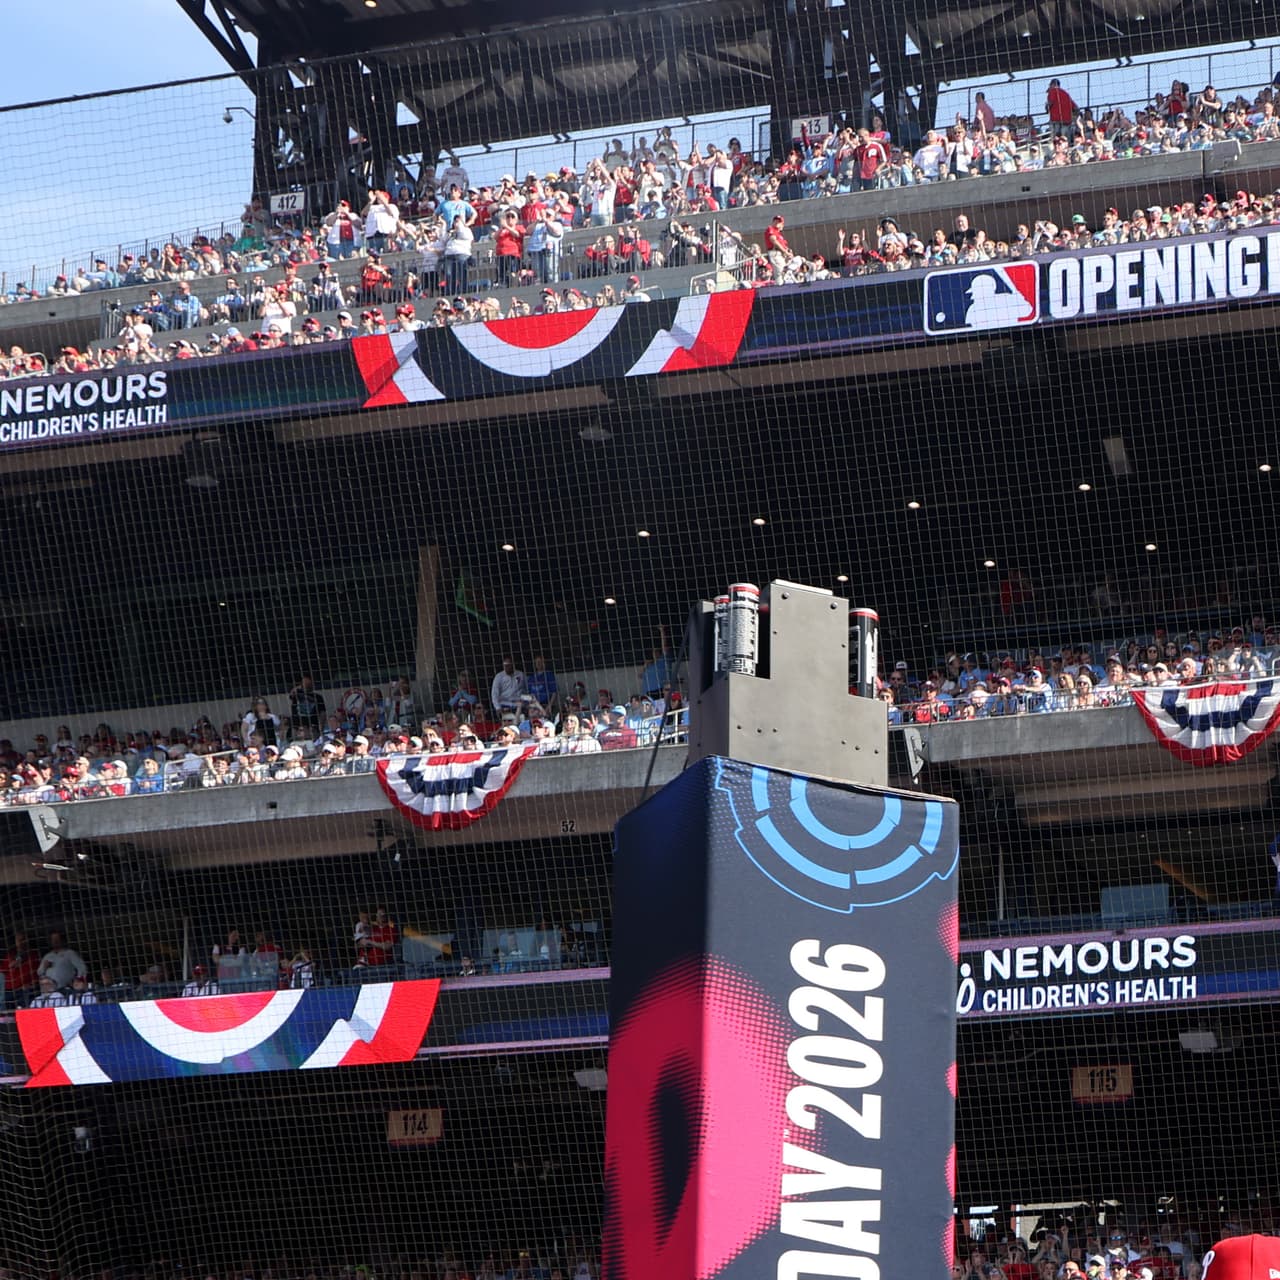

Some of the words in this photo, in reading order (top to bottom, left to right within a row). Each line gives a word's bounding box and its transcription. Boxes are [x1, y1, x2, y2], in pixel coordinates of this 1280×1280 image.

[277, 194, 297, 211] 412
[1048, 235, 1261, 319] OPENING
[0, 371, 168, 417] NEMOURS
[0, 411, 99, 443] CHILDREN'S
[102, 403, 168, 431] HEALTH
[561, 820, 576, 833] 52
[983, 935, 1197, 982] NEMOURS
[983, 981, 1110, 1013] CHILDREN'S
[1115, 975, 1198, 1004] HEALTH
[786, 938, 887, 1140] 2026
[1090, 1066, 1118, 1094] 115
[402, 1112, 429, 1137] 114
